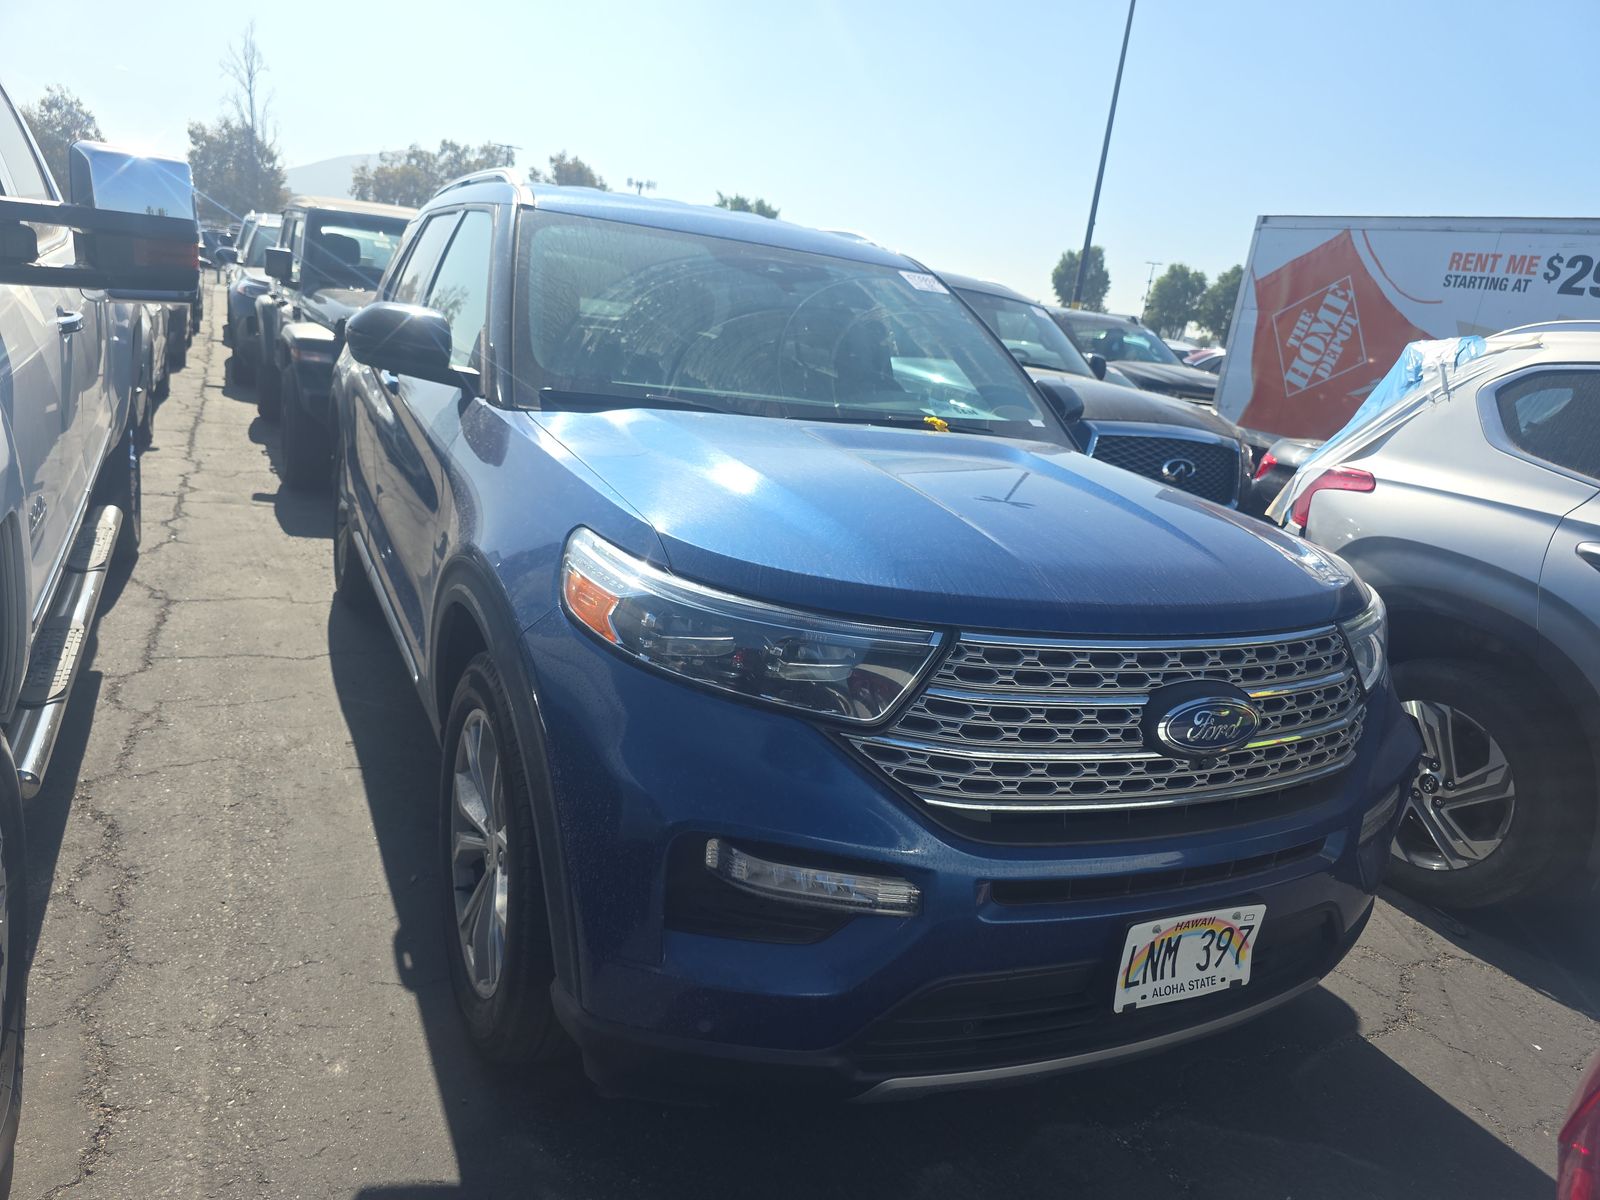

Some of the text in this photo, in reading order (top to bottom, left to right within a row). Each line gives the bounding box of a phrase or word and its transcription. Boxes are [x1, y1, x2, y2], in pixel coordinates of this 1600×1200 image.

[1448, 252, 1542, 276] RENT ME
[1443, 274, 1532, 293] STARTING AT
[1285, 283, 1354, 389] HOME
[1286, 308, 1315, 348] THE
[1315, 311, 1359, 380] DEPOT
[1187, 710, 1243, 742] Ford
[1175, 916, 1216, 931] HAWAII
[1124, 925, 1255, 989] LNM 397
[1152, 975, 1217, 998] ALOHA STATE
